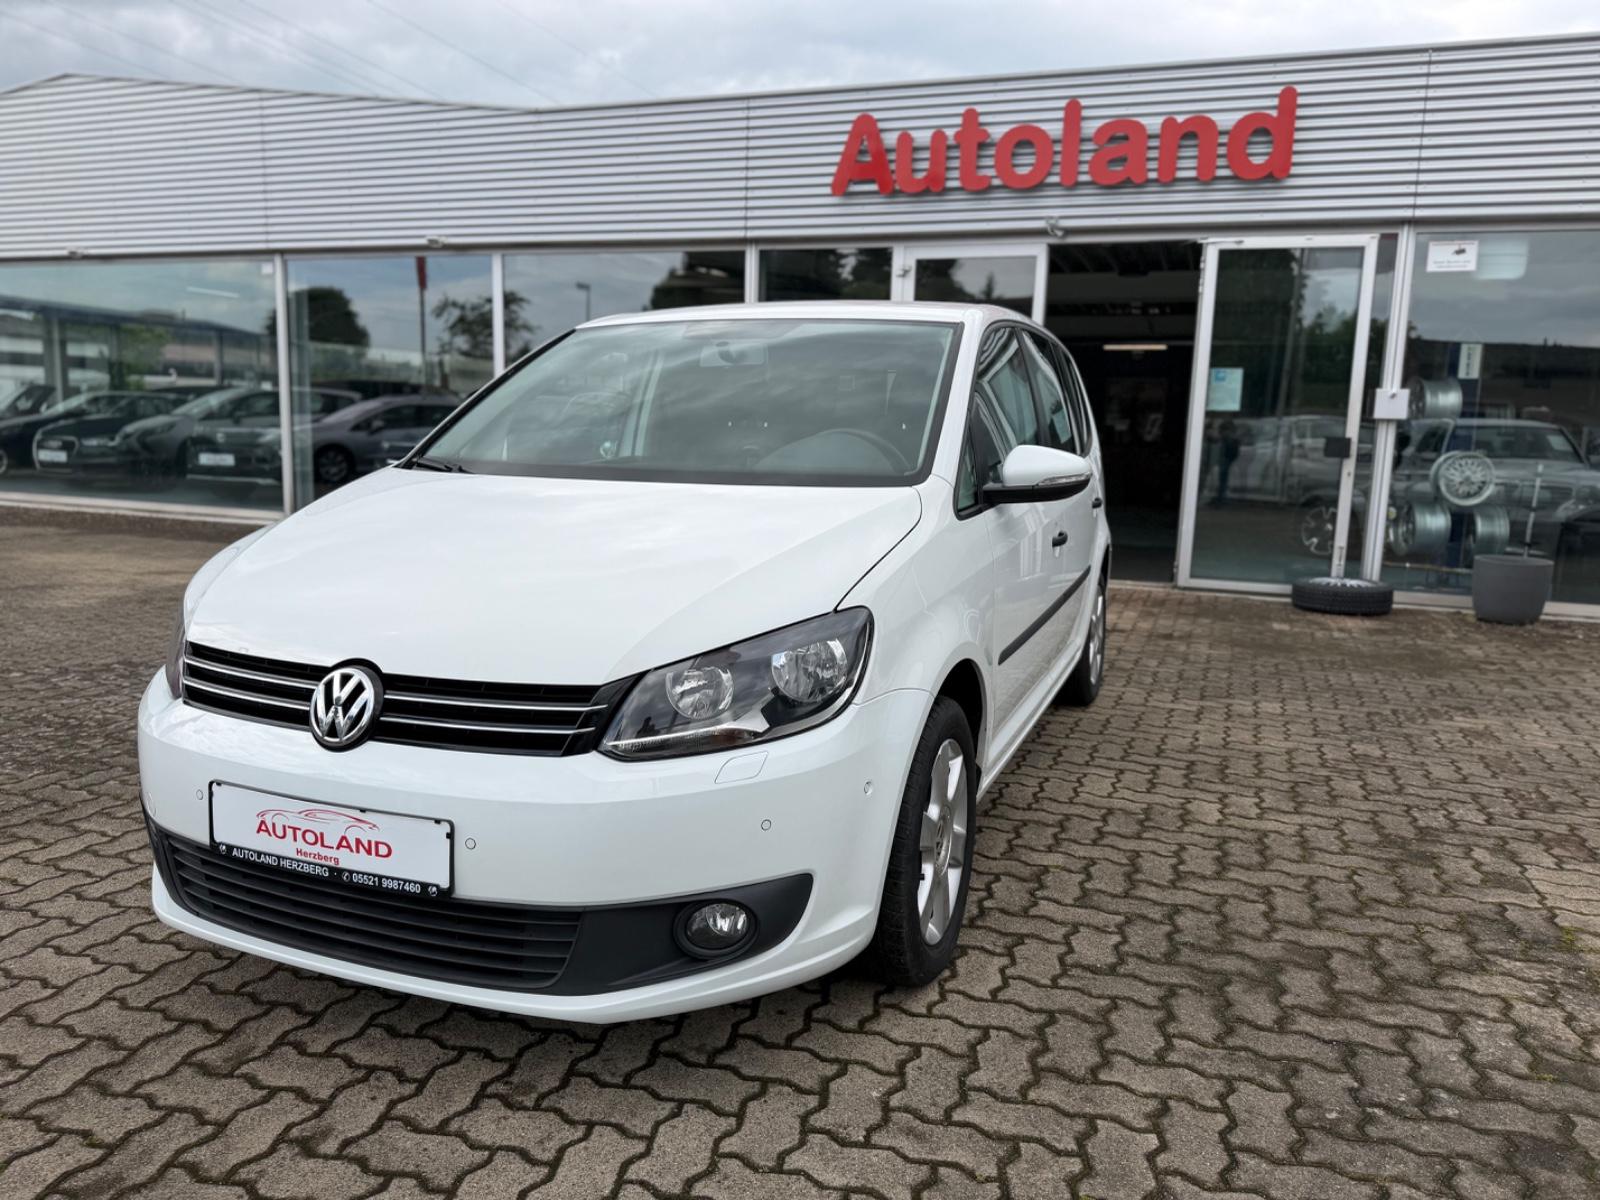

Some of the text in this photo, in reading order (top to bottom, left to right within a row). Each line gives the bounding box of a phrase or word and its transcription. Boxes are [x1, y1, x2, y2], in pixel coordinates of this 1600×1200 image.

[831, 86, 1299, 196] Autoland
[256, 819, 393, 859] AUTOLAND
[296, 848, 340, 866] Herzberg
[232, 847, 421, 893] AUTOLAND HERZBERG 05521 9987460
